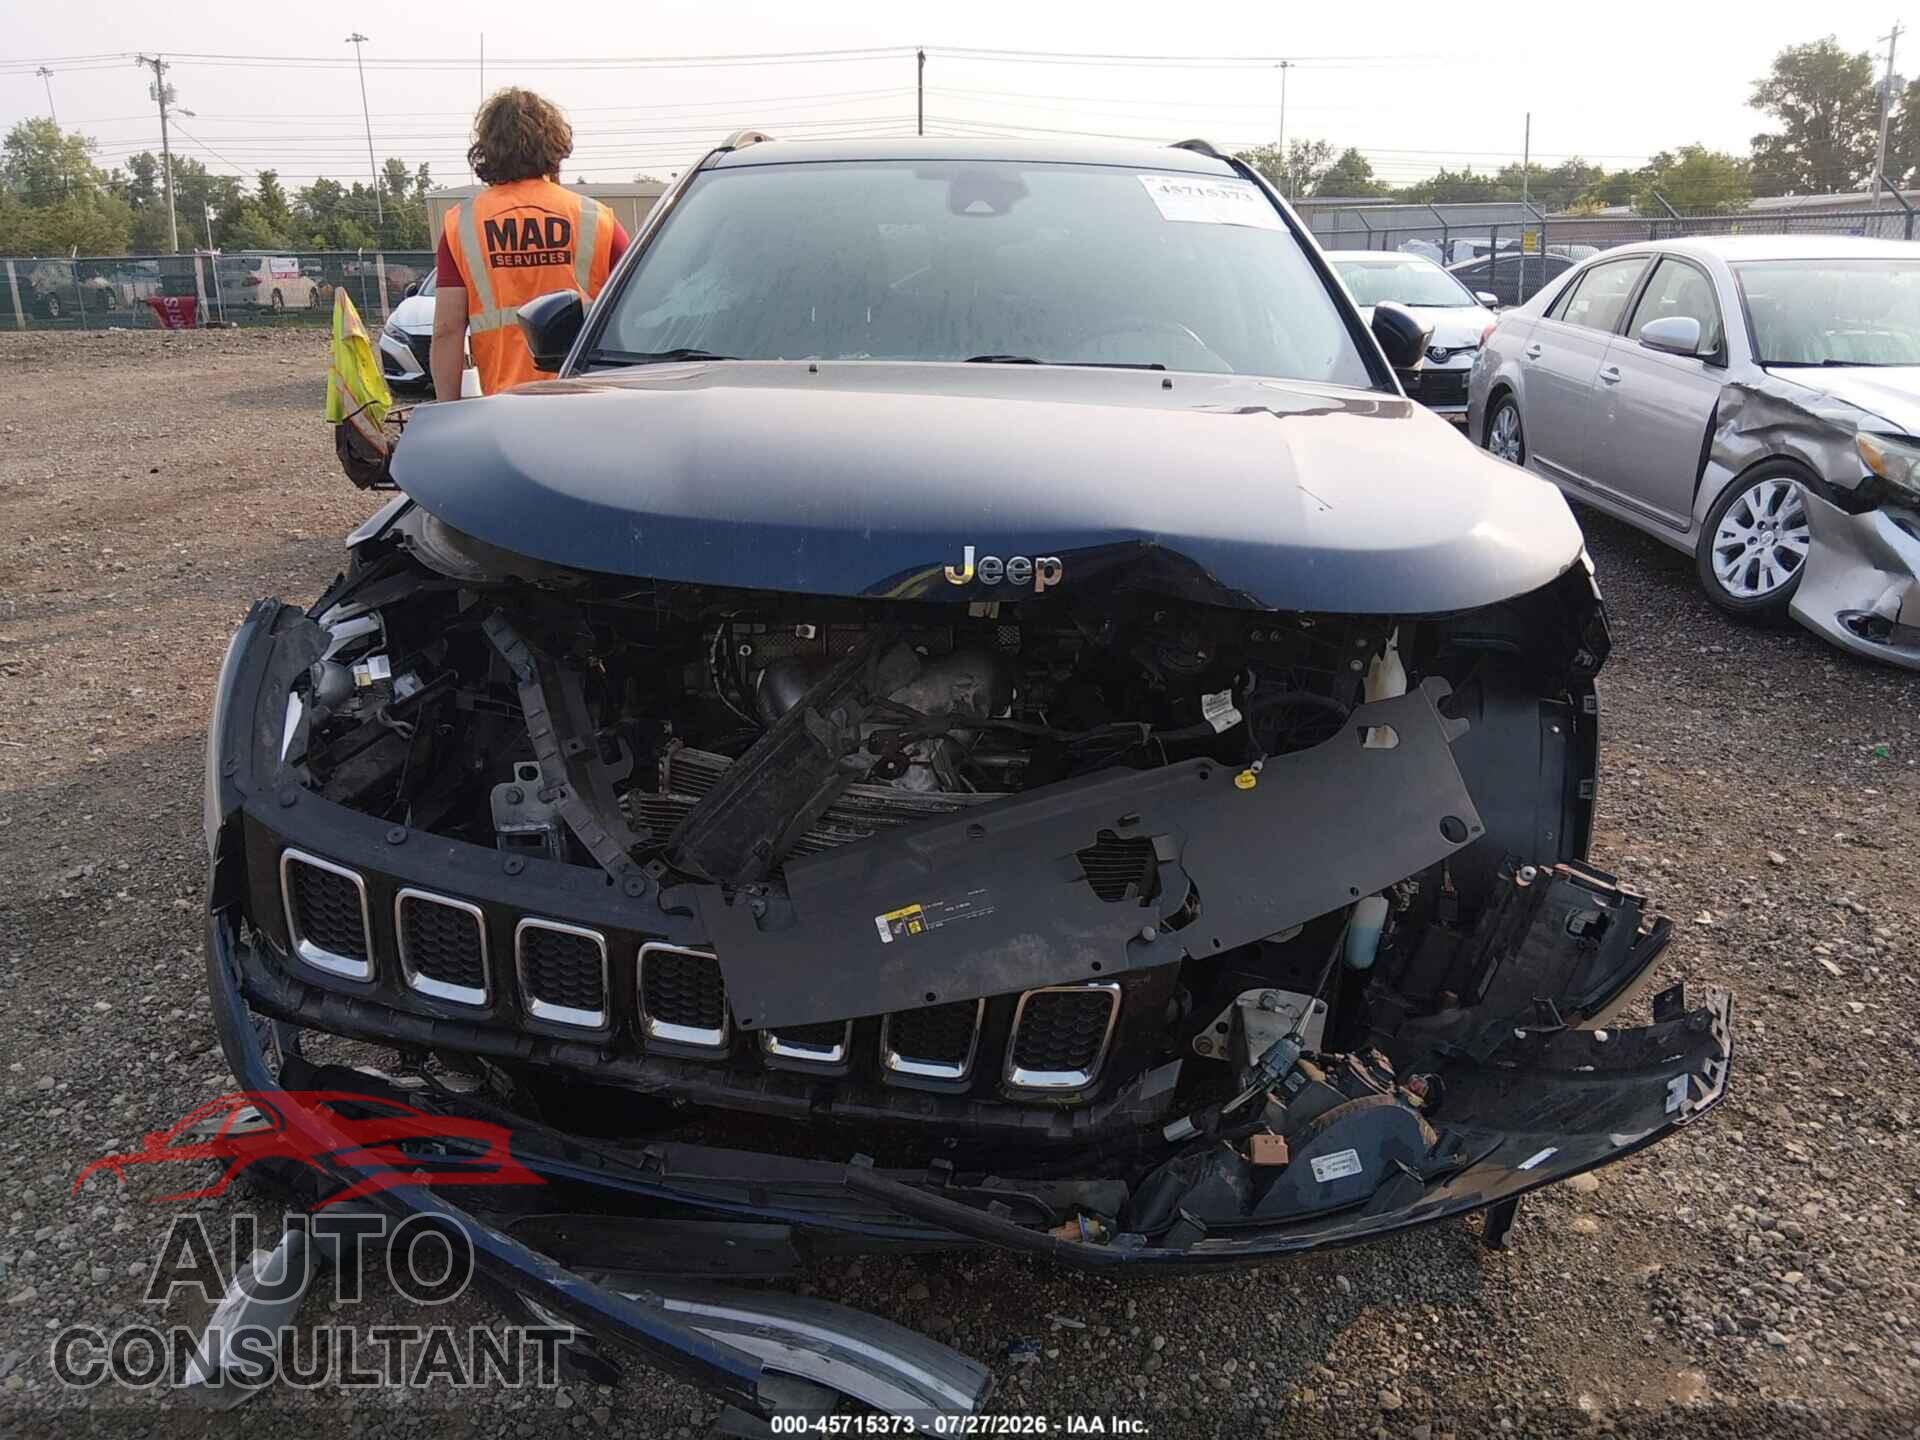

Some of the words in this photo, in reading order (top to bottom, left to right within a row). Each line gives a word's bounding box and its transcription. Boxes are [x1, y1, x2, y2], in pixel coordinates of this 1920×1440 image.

[483, 216, 571, 252] MAD
[495, 252, 565, 266] SERVICES
[944, 545, 1063, 592] Jeep
